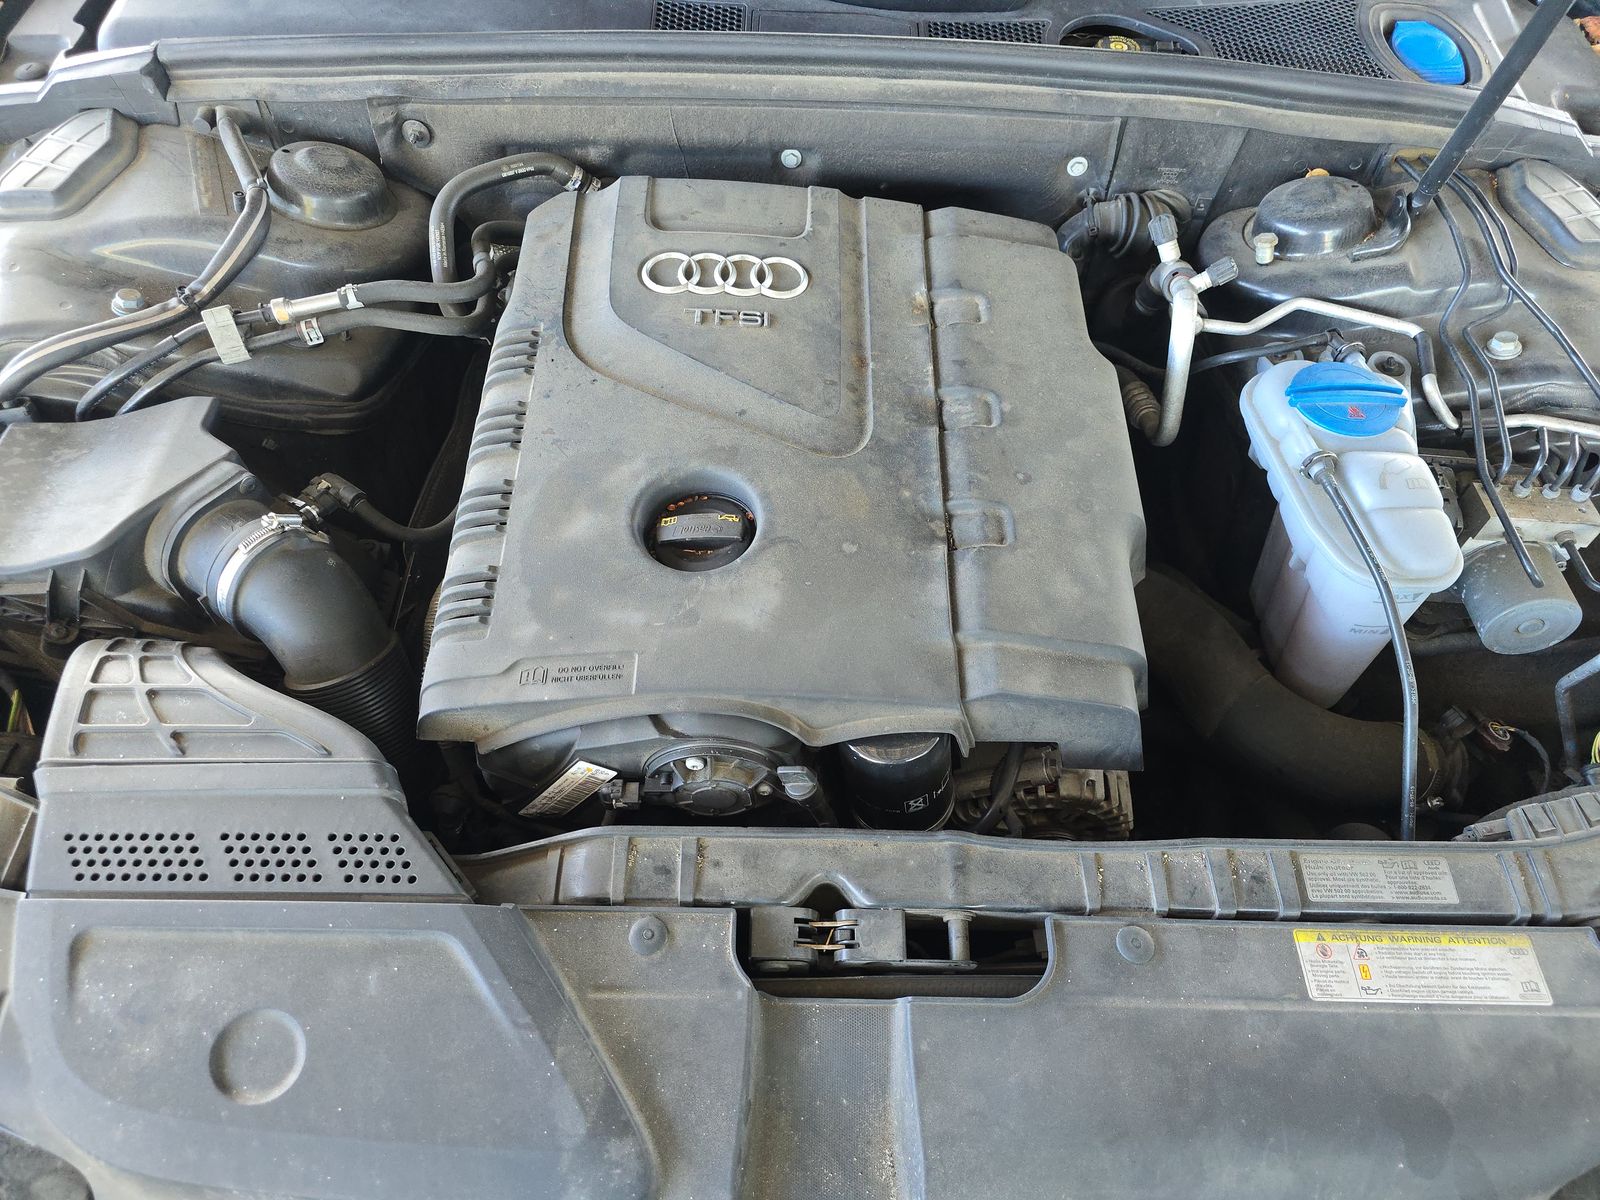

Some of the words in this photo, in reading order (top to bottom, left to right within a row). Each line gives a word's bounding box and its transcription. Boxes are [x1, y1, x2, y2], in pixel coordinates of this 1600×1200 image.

[684, 307, 771, 327] TFSI
[558, 665, 569, 674] DO
[570, 664, 587, 673] NOT
[551, 675, 575, 684] NICHT
[1330, 933, 1384, 943] ACHTUNG
[1387, 934, 1442, 944] WARNING
[1447, 935, 1507, 945] ATTENTION
